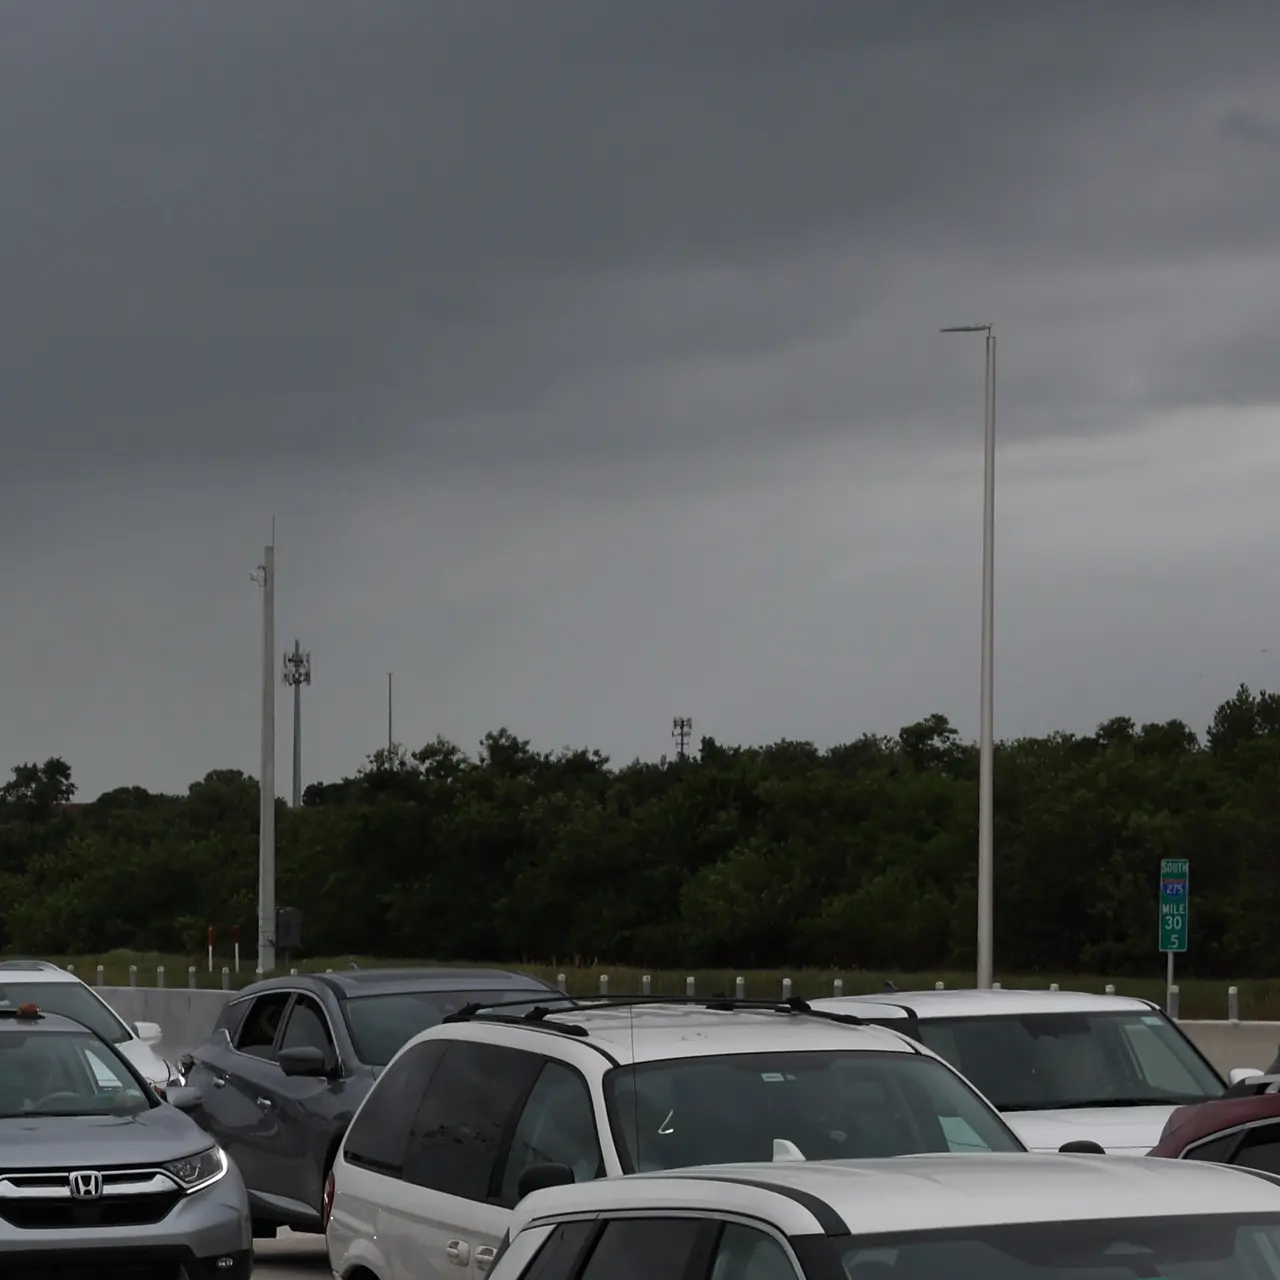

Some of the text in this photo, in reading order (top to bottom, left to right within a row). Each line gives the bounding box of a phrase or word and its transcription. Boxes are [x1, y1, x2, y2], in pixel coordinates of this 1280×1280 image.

[1162, 864, 1188, 873] SOUTH
[1167, 885, 1183, 894] 275
[1162, 905, 1185, 914] MILE
[1165, 916, 1182, 929] 30
